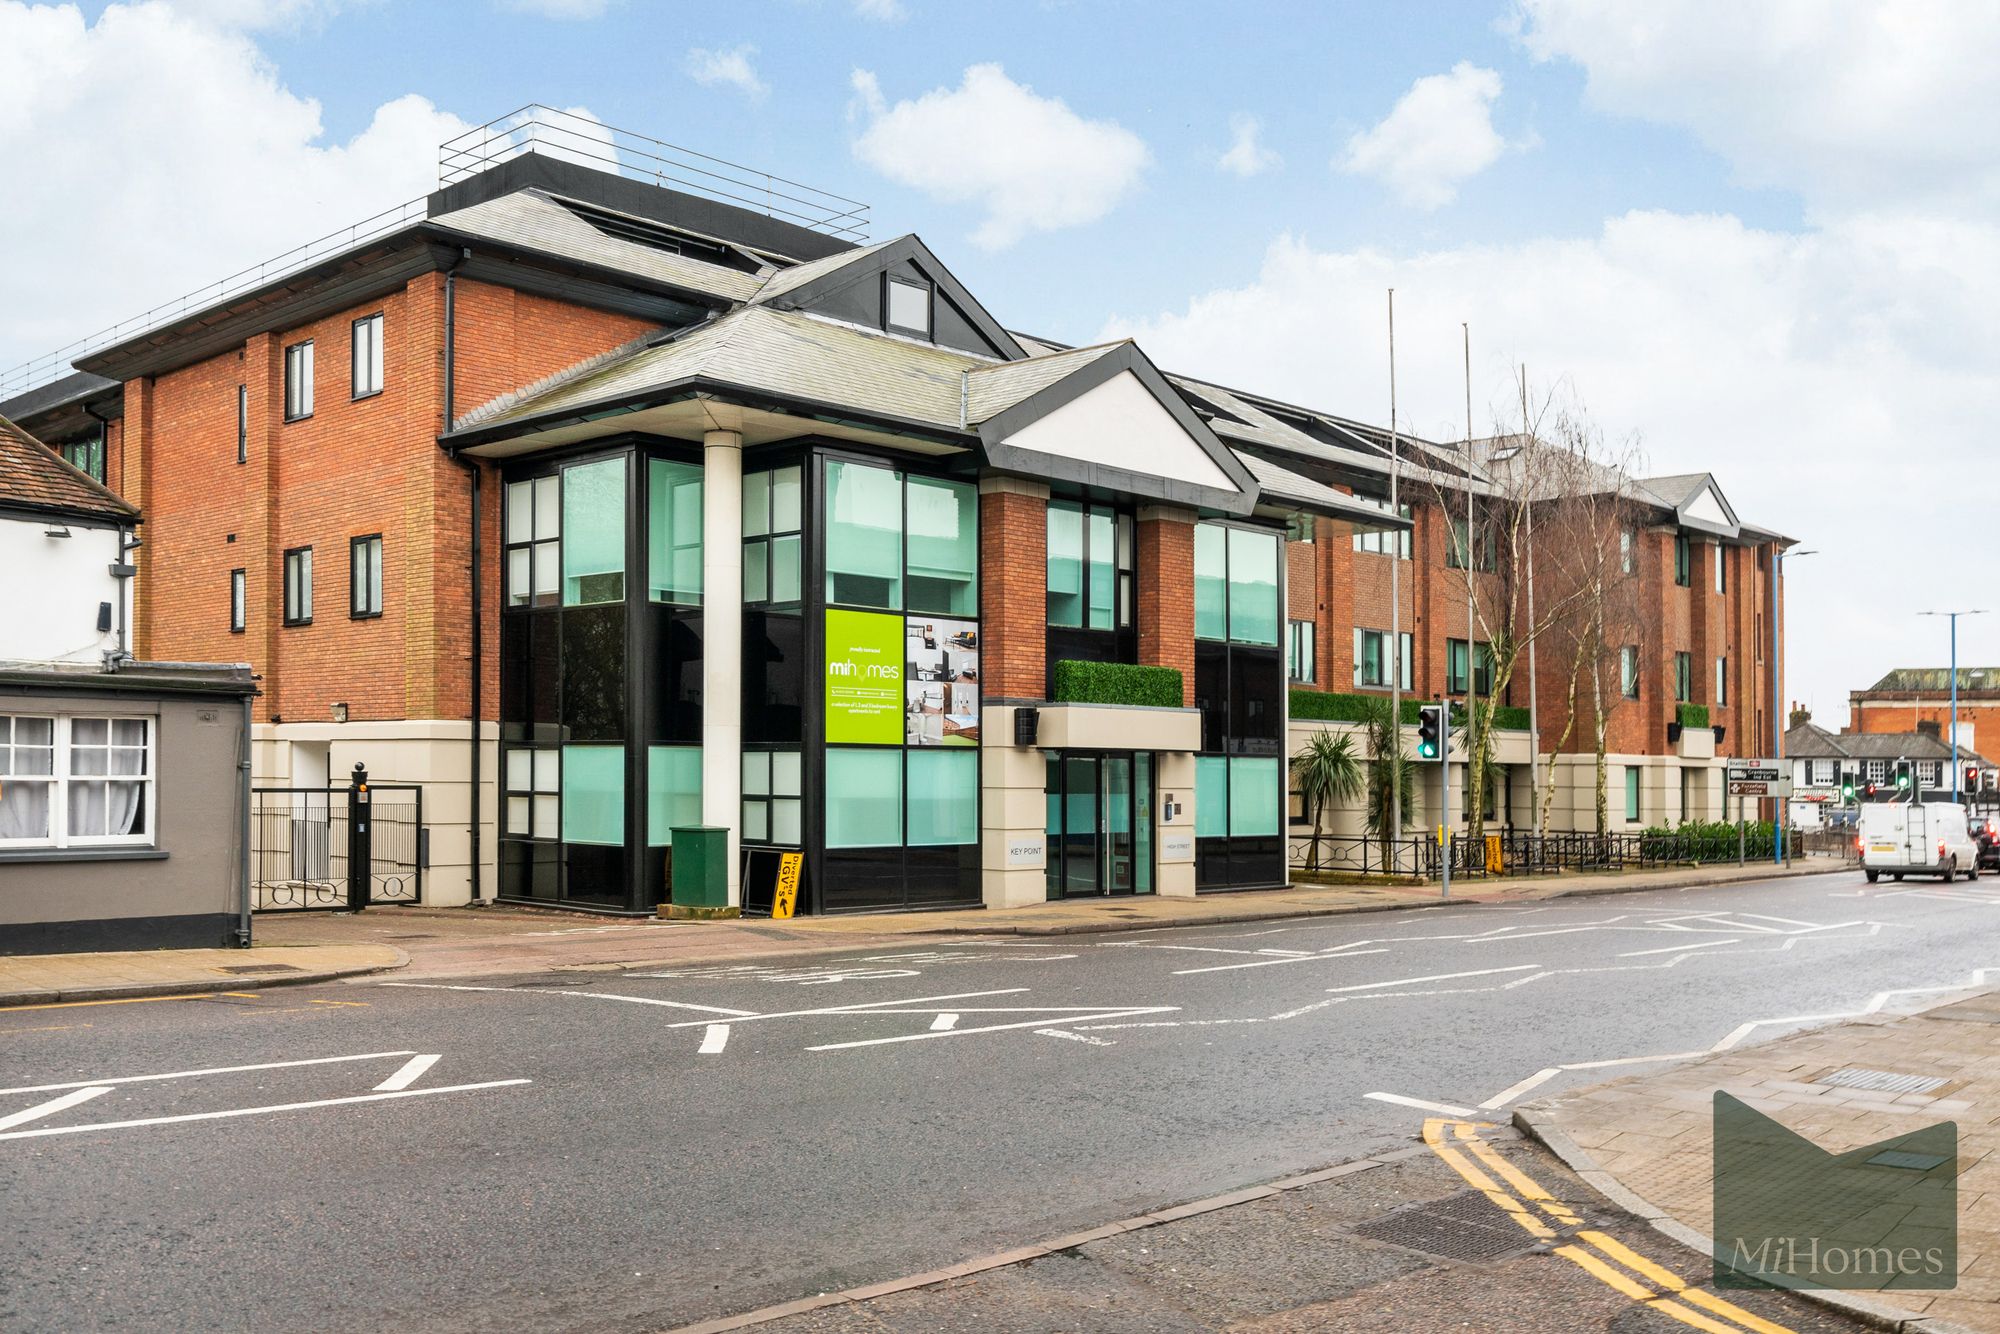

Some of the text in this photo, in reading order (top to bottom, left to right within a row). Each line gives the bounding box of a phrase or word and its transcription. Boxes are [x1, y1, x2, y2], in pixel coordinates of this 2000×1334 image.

[1010, 847, 1042, 856] KEY POINT
[787, 855, 799, 895] Diverted
